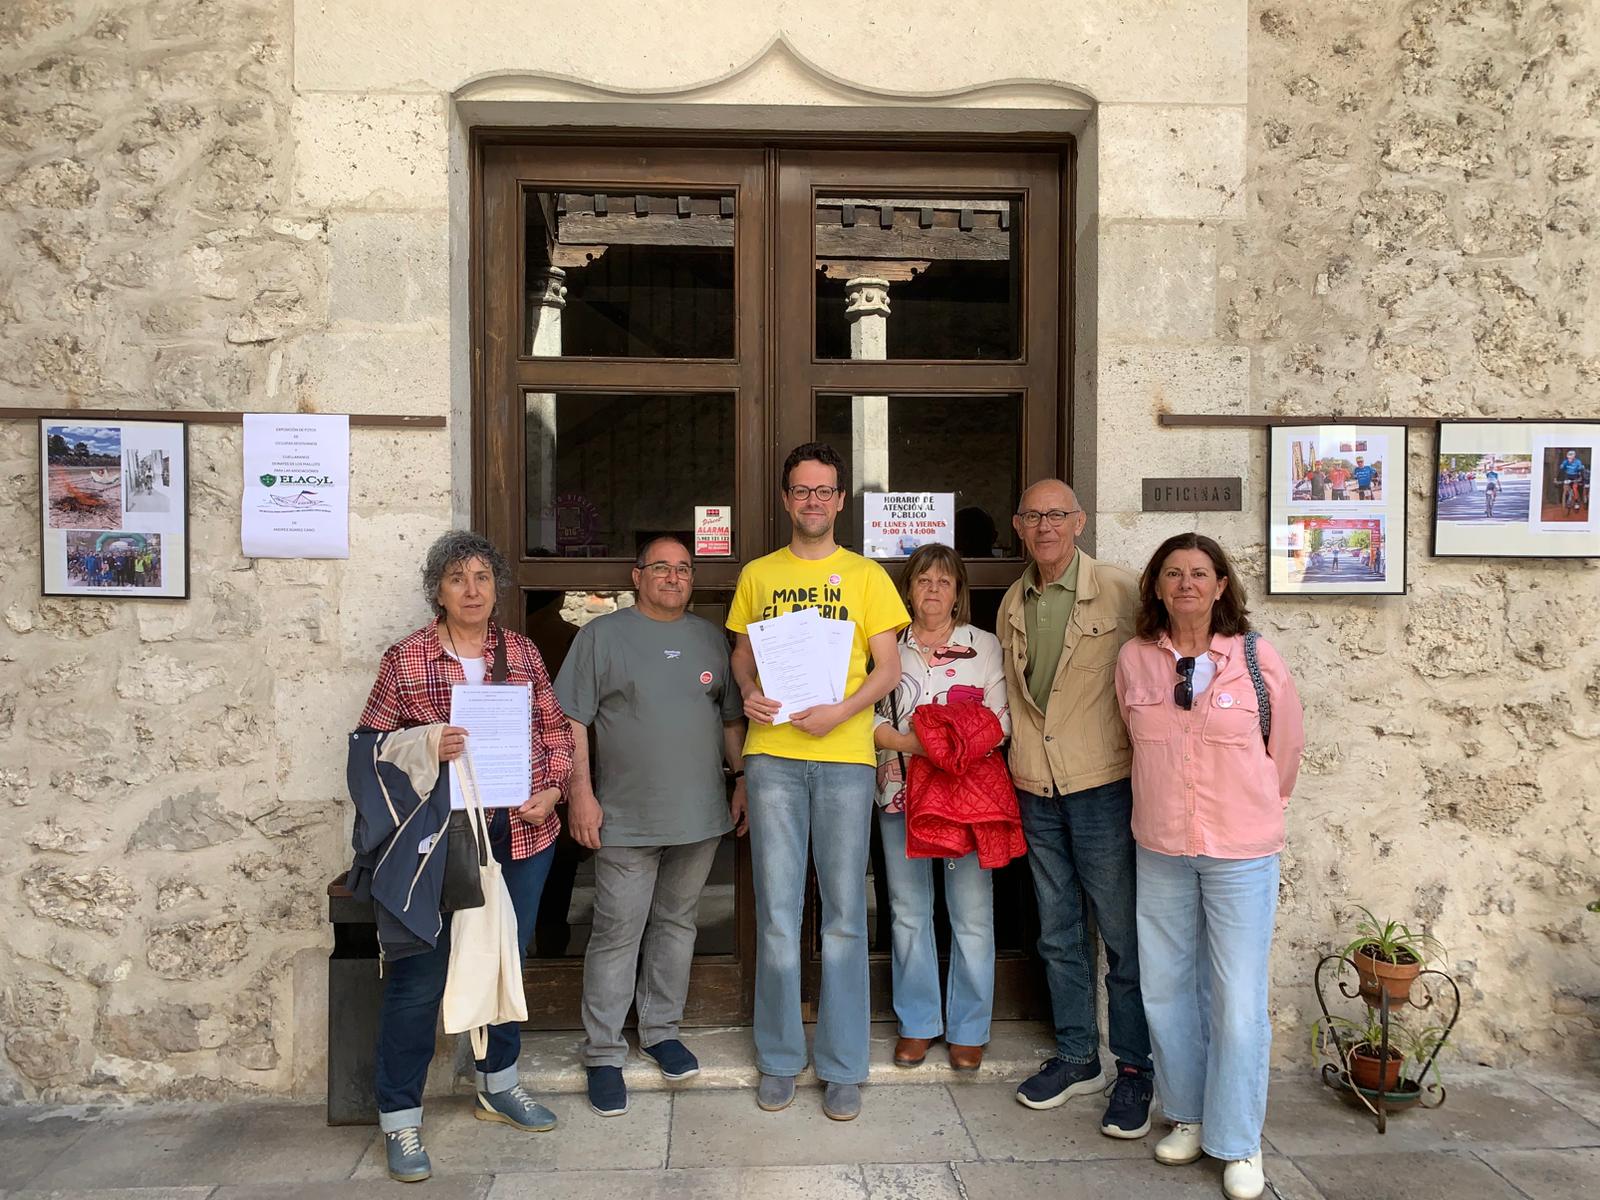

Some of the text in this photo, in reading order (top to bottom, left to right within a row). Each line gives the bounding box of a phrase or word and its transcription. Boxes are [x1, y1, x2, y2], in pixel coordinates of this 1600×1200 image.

[1154, 486, 1231, 502] OFICINAS
[884, 496, 920, 504] HORARIO
[883, 503, 922, 511] ATENCIÓN
[916, 520, 946, 528] VIERNES
[773, 587, 818, 604] MADE
